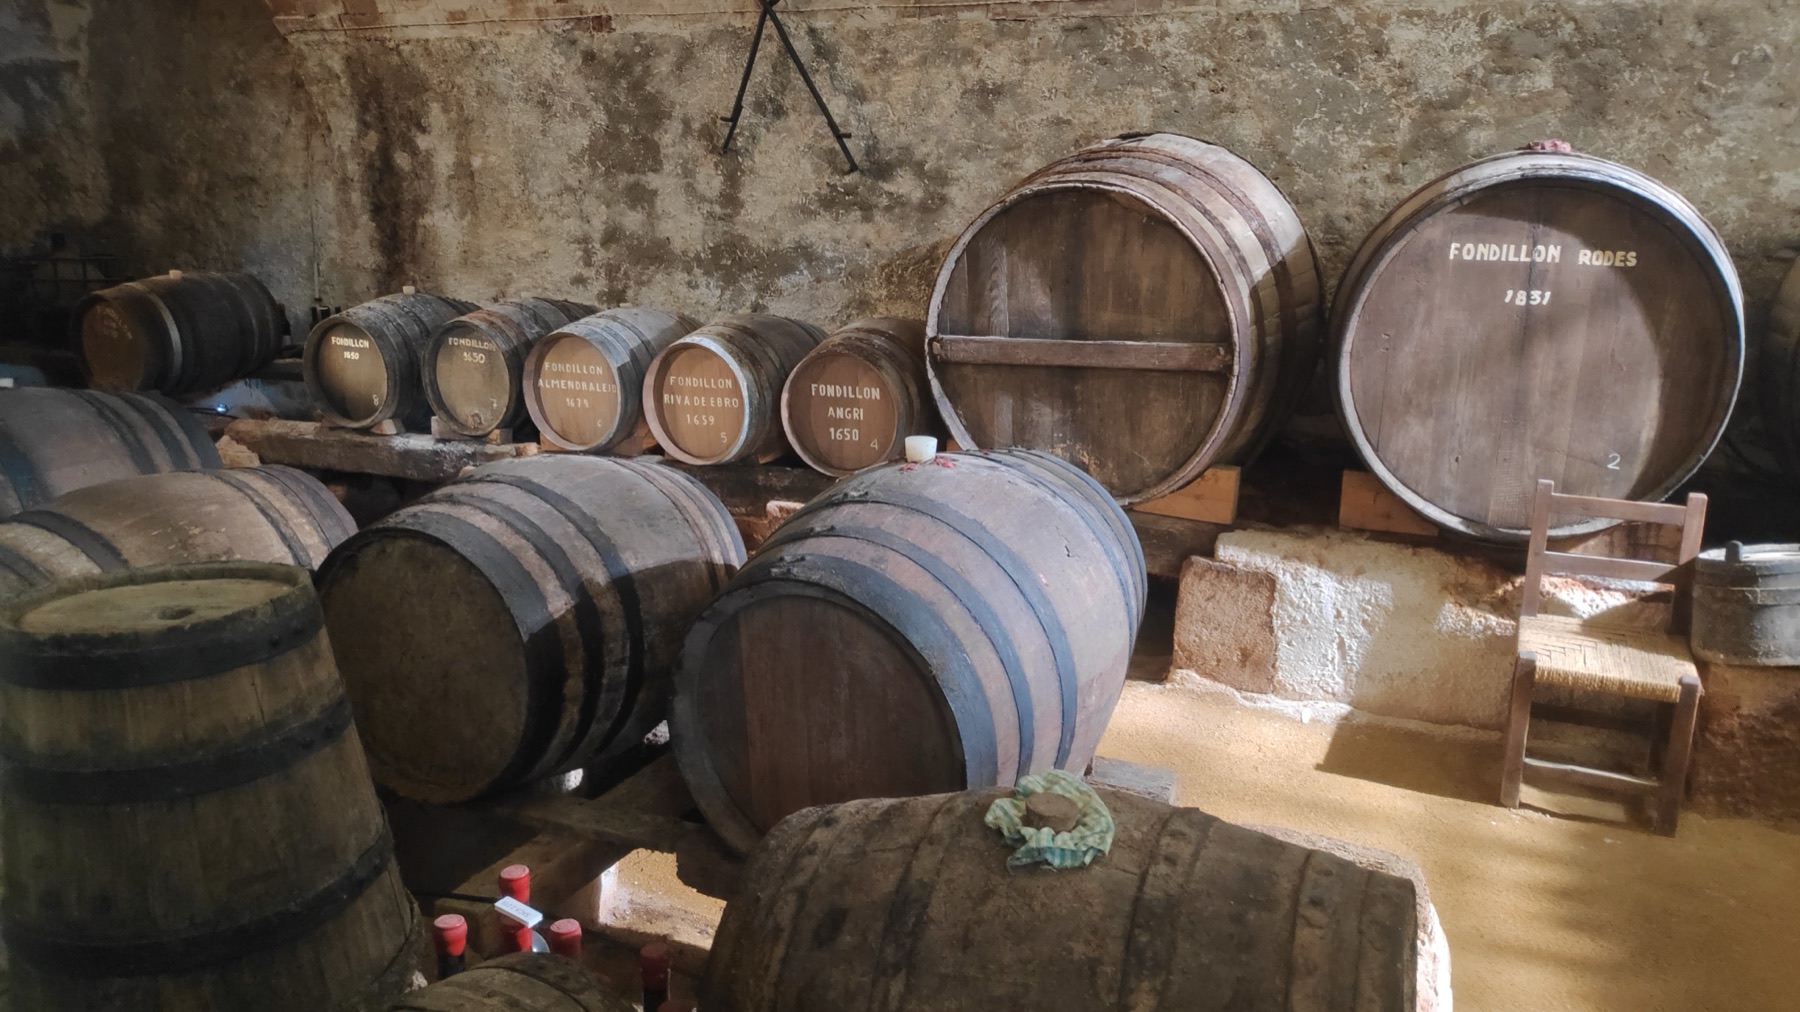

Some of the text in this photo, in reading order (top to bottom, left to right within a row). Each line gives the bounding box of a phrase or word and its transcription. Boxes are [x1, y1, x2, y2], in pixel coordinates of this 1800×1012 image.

[1449, 242, 1638, 267] FONDILLON RODES
[1504, 289, 1551, 306] 1831
[331, 336, 369, 348] FONDILLON
[448, 337, 496, 351] FONDILLON
[544, 362, 603, 375] FONDILLON
[537, 378, 617, 393] ALMENDRALEJO
[669, 376, 732, 389] FONDILLON
[811, 383, 880, 400] FONDILLON
[372, 394, 379, 406] 8
[489, 397, 497, 409] 7
[663, 393, 739, 408] RIVA DE EBRO
[686, 414, 715, 426] 1659
[827, 406, 864, 421] ANGRI
[720, 432, 729, 443] 5
[829, 427, 859, 441] 1650
[870, 438, 879, 451] 4
[1606, 453, 1620, 470] 2
